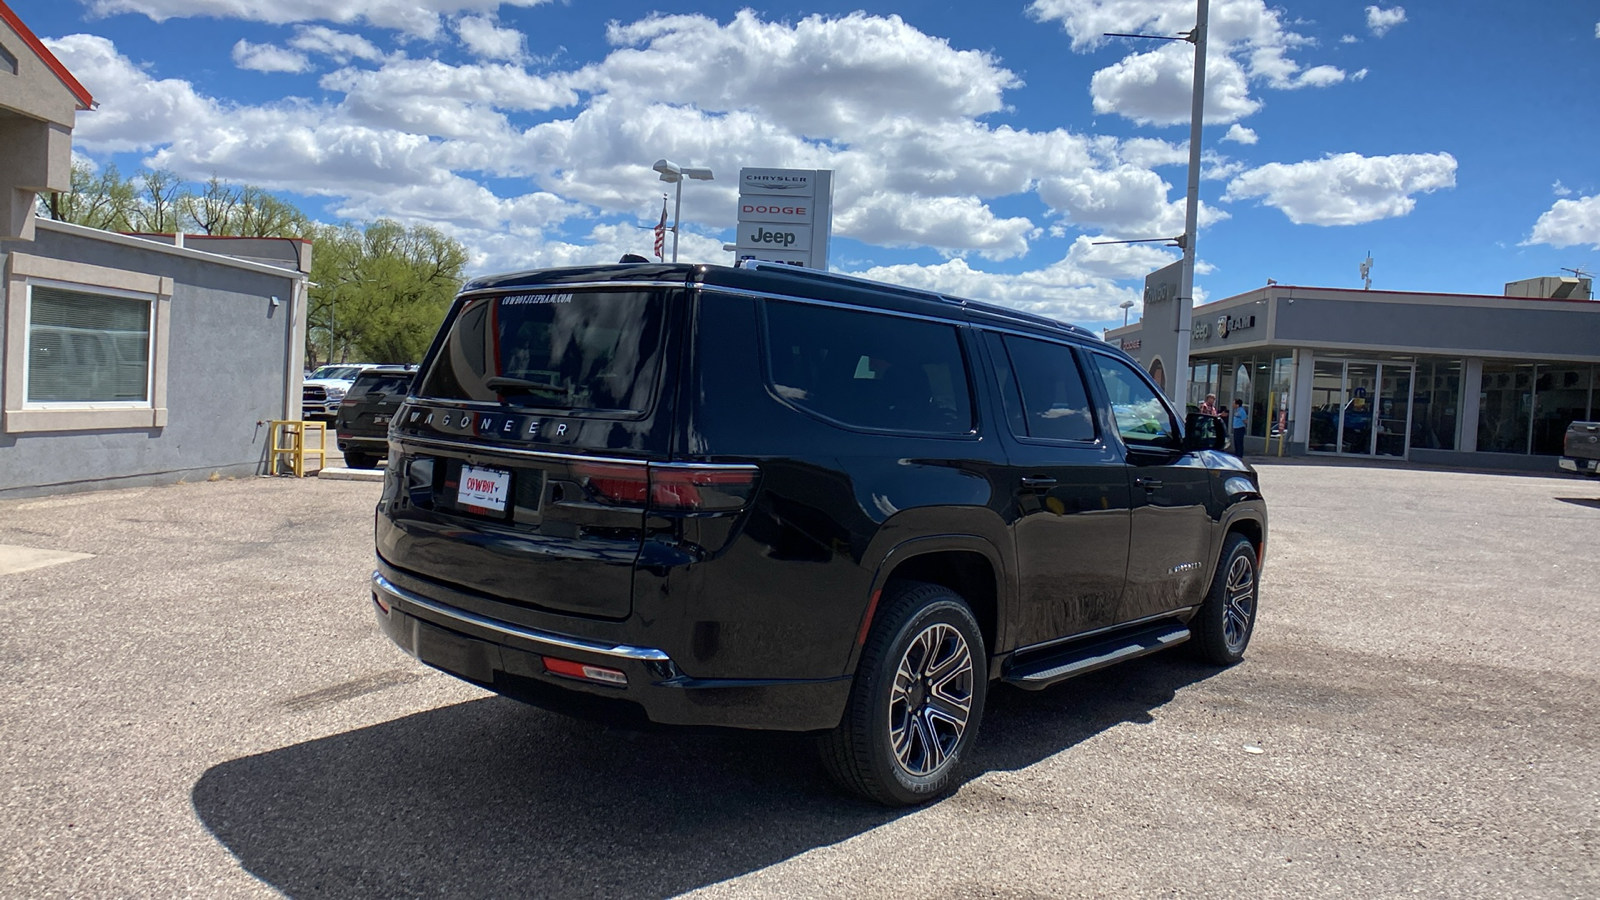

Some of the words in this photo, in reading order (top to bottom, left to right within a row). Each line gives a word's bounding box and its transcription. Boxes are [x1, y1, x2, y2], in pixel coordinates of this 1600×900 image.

[743, 205, 806, 215] DODGE
[751, 227, 795, 247] Jeep
[1227, 316, 1252, 331] RAM
[409, 411, 567, 436] WAGONEER
[467, 477, 495, 494] COWBOY
